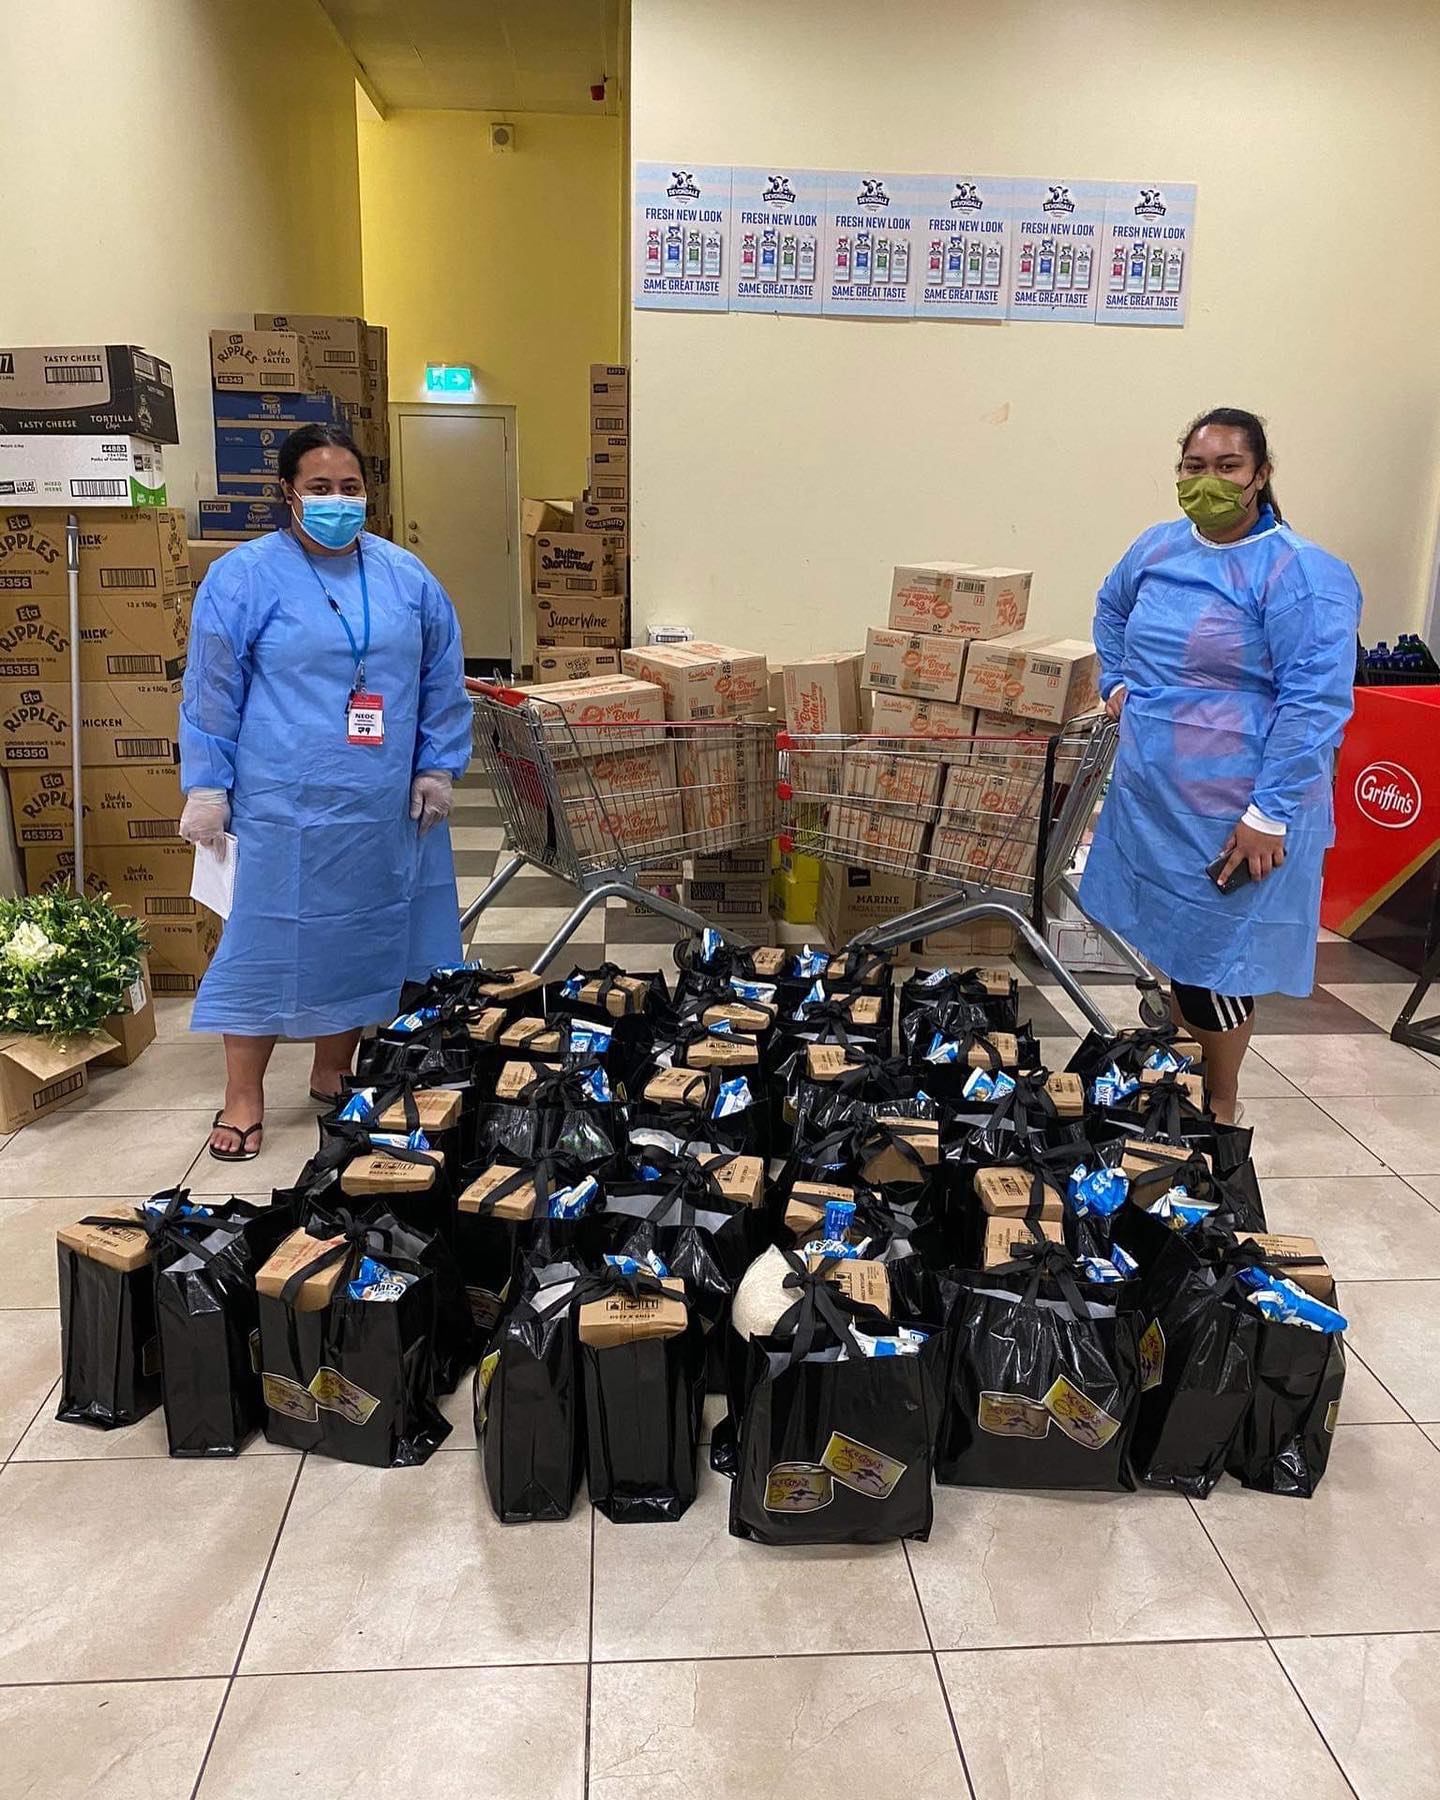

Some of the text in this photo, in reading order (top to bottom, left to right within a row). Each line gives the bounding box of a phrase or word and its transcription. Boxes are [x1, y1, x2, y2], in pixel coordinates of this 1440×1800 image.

[645, 208, 722, 222] FRESH NEW LOOK
[742, 212, 817, 226] FRESH NEW LOOK
[836, 216, 910, 230] FRESH NEW LOOK
[929, 219, 1003, 232] FRESH NEW LOOK
[1021, 222, 1094, 236] FRESH NEW LOOK
[1112, 226, 1185, 239] FRESH NEW LOOK
[644, 280, 719, 292] SAME GREAT TASTE
[738, 283, 813, 296] SAME GREAT TASTE
[832, 286, 906, 298] SAME GREAT TASTE
[924, 290, 998, 302] SAME GREAT TASTE
[1015, 292, 1088, 304] SAME GREAT TASTE
[1106, 296, 1178, 307] SAME GREAT TASTE
[218, 346, 258, 364] RIPPLES
[18, 420, 77, 429] TASTY CHEESE
[204, 504, 229, 512] EXPORT
[9, 515, 28, 529] Eta
[78, 535, 102, 545] ICK
[0, 533, 60, 563] IPPLES
[553, 547, 585, 561] Butter
[542, 556, 594, 572] Shortbread
[0, 578, 30, 587] 5356
[18, 606, 40, 620] Eta
[0, 623, 70, 653] RIPPLES
[80, 628, 108, 639] HICK
[22, 692, 40, 704] Eta
[4, 706, 68, 733] RIPPLES
[612, 708, 640, 722] Bowl
[82, 718, 122, 728] HICKEN
[8, 749, 46, 758] 45350
[42, 775, 62, 788] Eta
[1361, 775, 1414, 814] Griffin's
[23, 791, 91, 820] RIPPLS
[24, 830, 62, 840] 45352
[40, 867, 108, 894] RIPES
[124, 874, 154, 882] SALTED
[856, 896, 900, 904] MARINE
